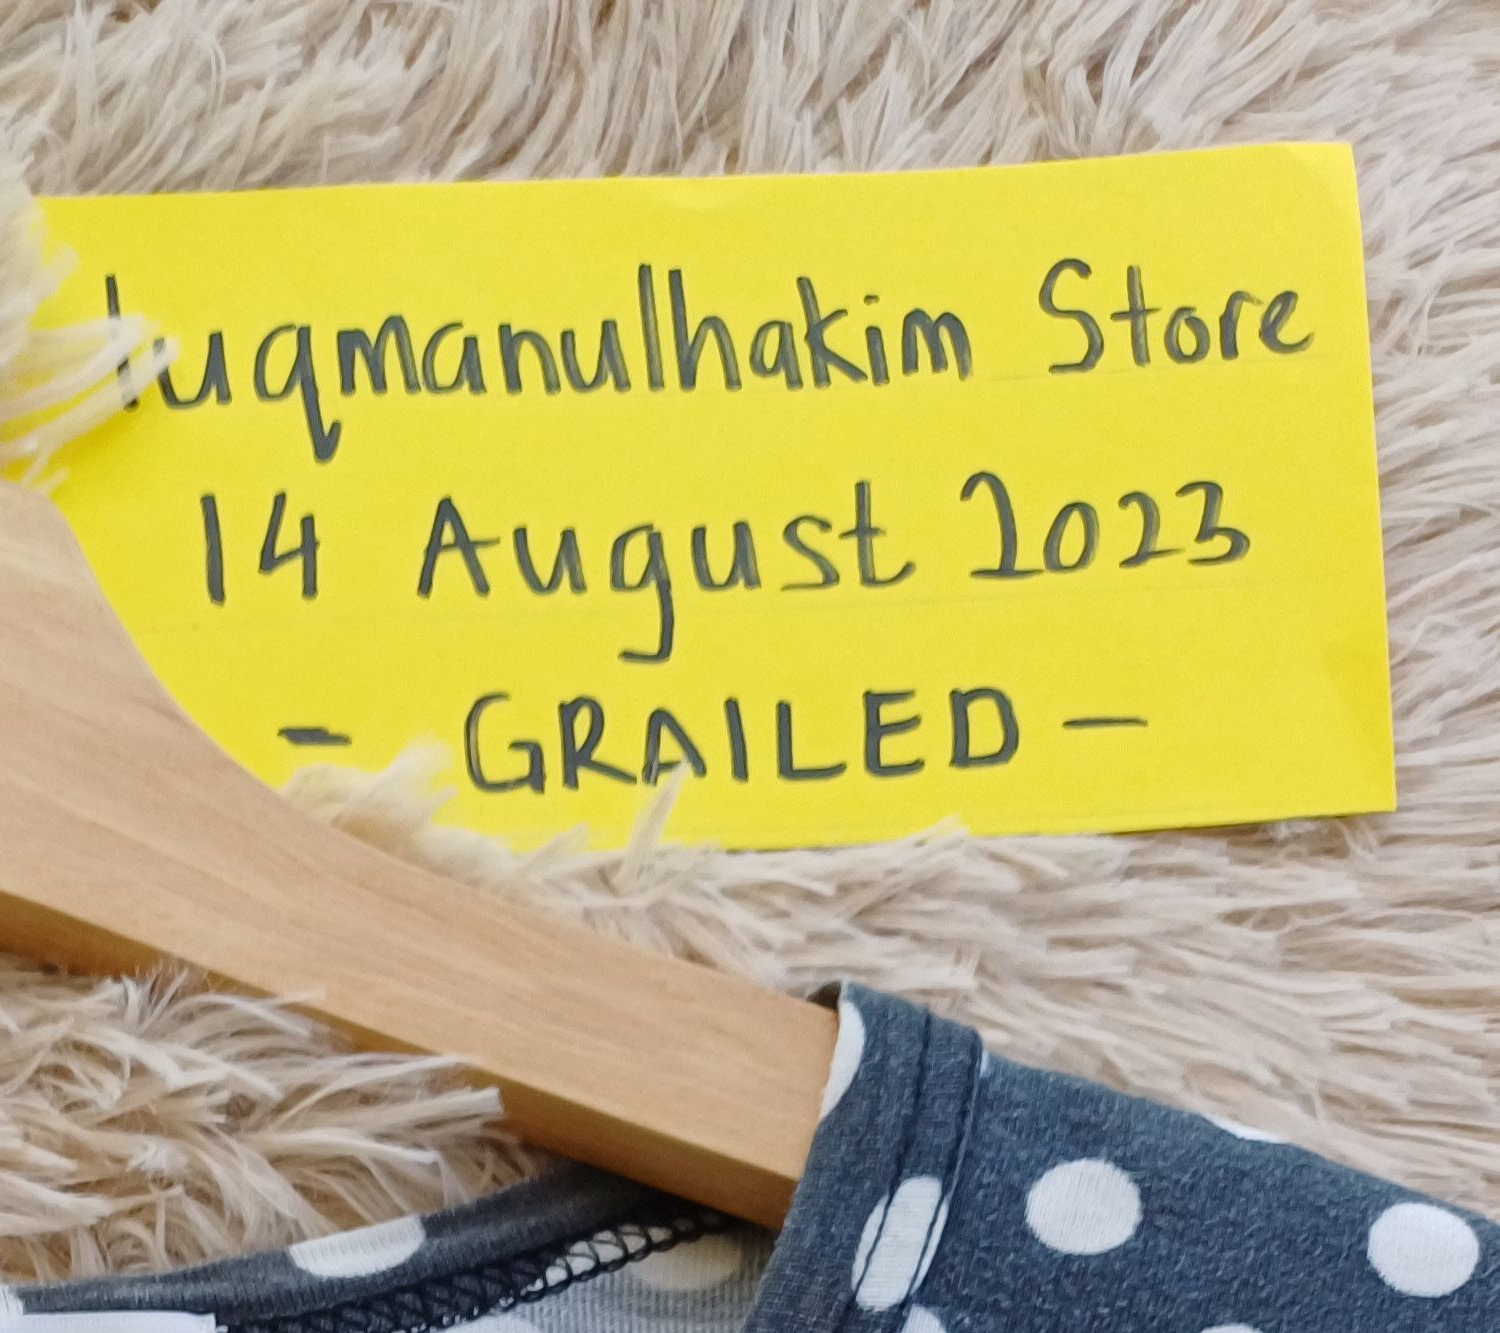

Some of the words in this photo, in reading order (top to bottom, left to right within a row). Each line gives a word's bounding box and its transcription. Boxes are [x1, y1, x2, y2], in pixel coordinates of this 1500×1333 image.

[1038, 257, 1312, 374] Store
[199, 490, 321, 607] 14
[416, 479, 916, 665] August
[959, 470, 1251, 580] 2023
[463, 686, 1020, 795] GRAILED
